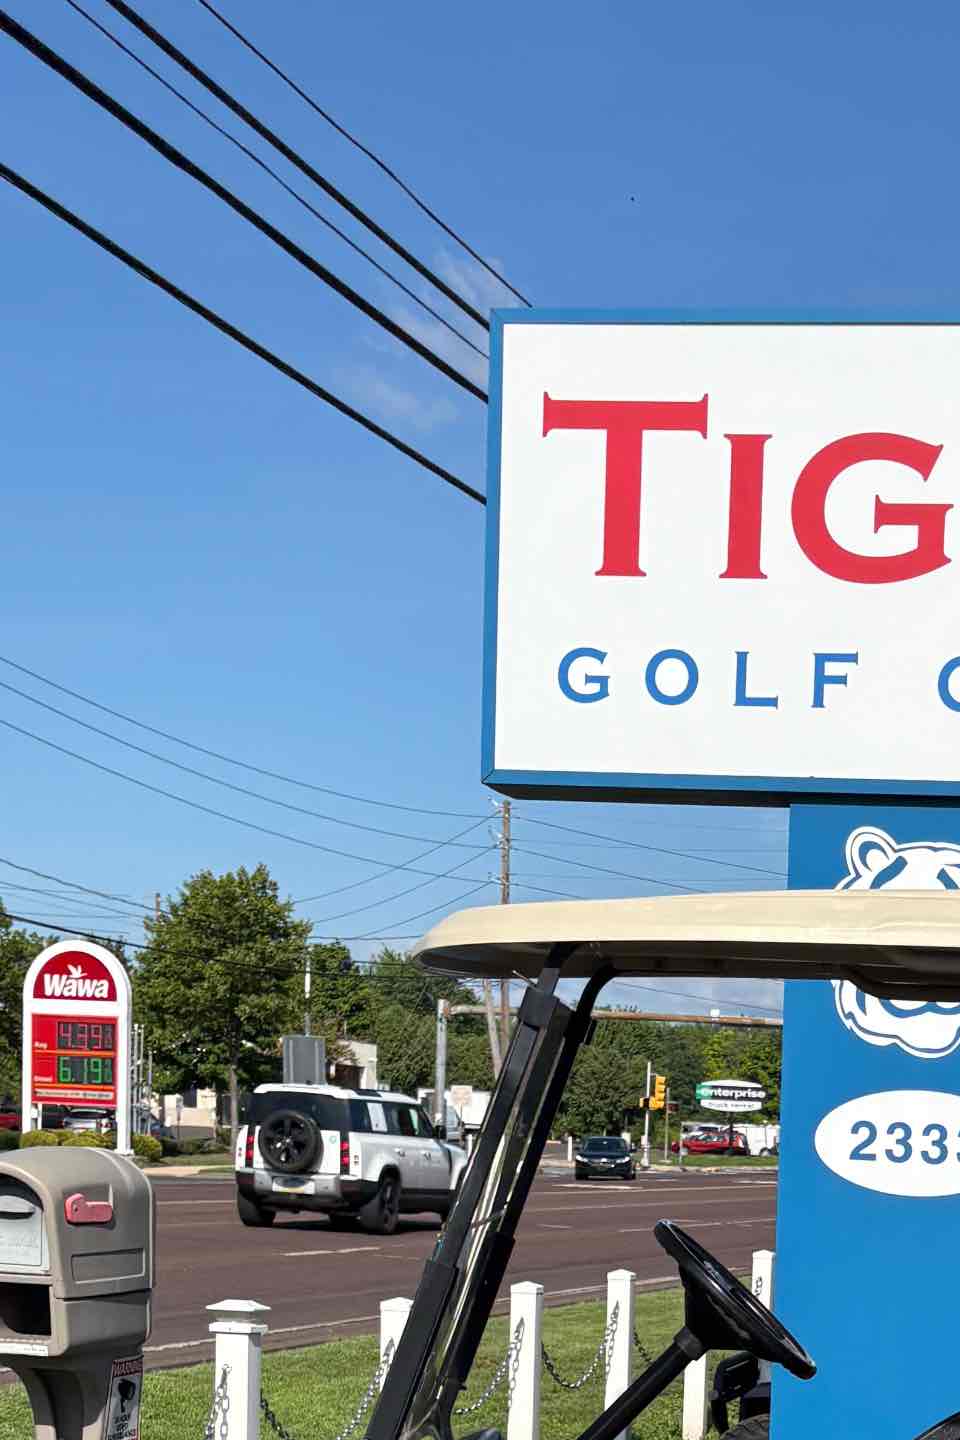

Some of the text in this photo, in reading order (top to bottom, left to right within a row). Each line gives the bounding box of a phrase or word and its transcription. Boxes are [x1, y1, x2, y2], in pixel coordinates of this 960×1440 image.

[557, 647, 859, 709] GOLF
[43, 972, 109, 998] Wawa
[700, 1088, 766, 1100] enterprise
